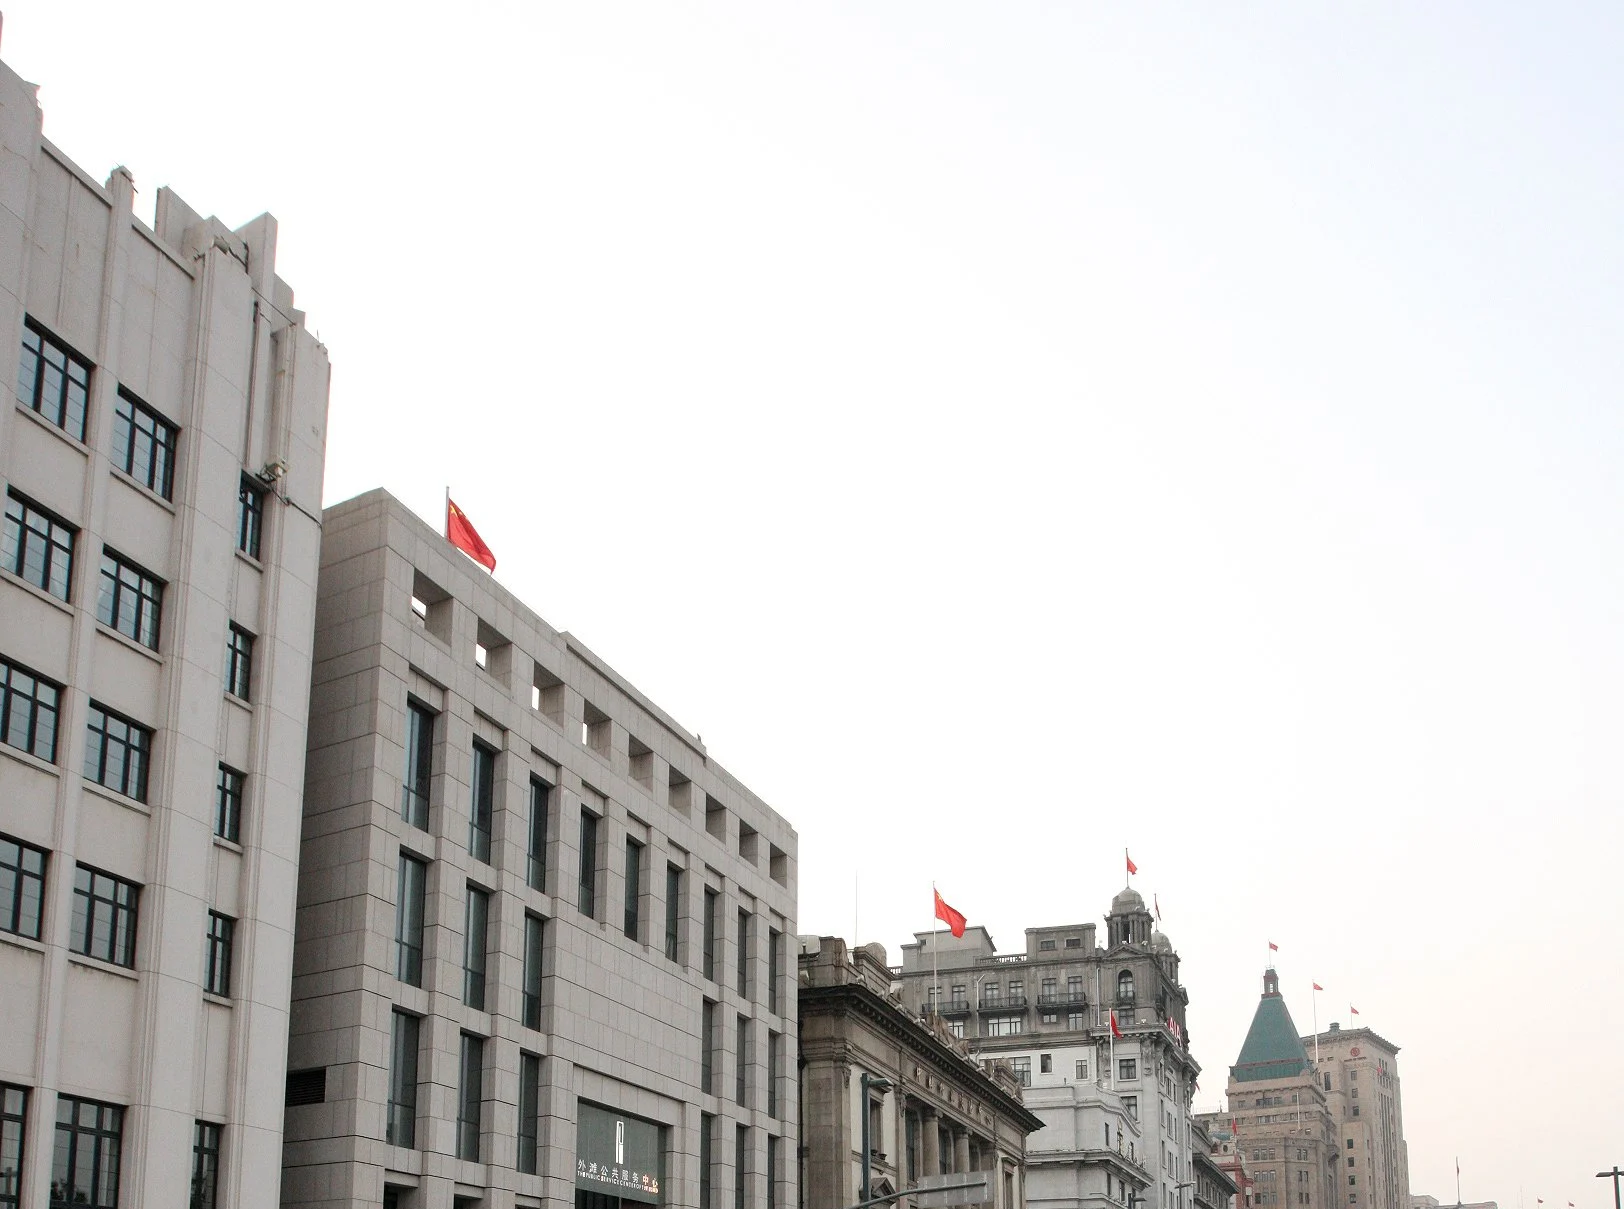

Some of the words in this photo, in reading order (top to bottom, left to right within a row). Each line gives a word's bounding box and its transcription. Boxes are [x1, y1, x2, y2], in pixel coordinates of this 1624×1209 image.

[1168, 1016, 1182, 1047] AIA
[577, 1158, 659, 1188] 外滩公共服务中心
